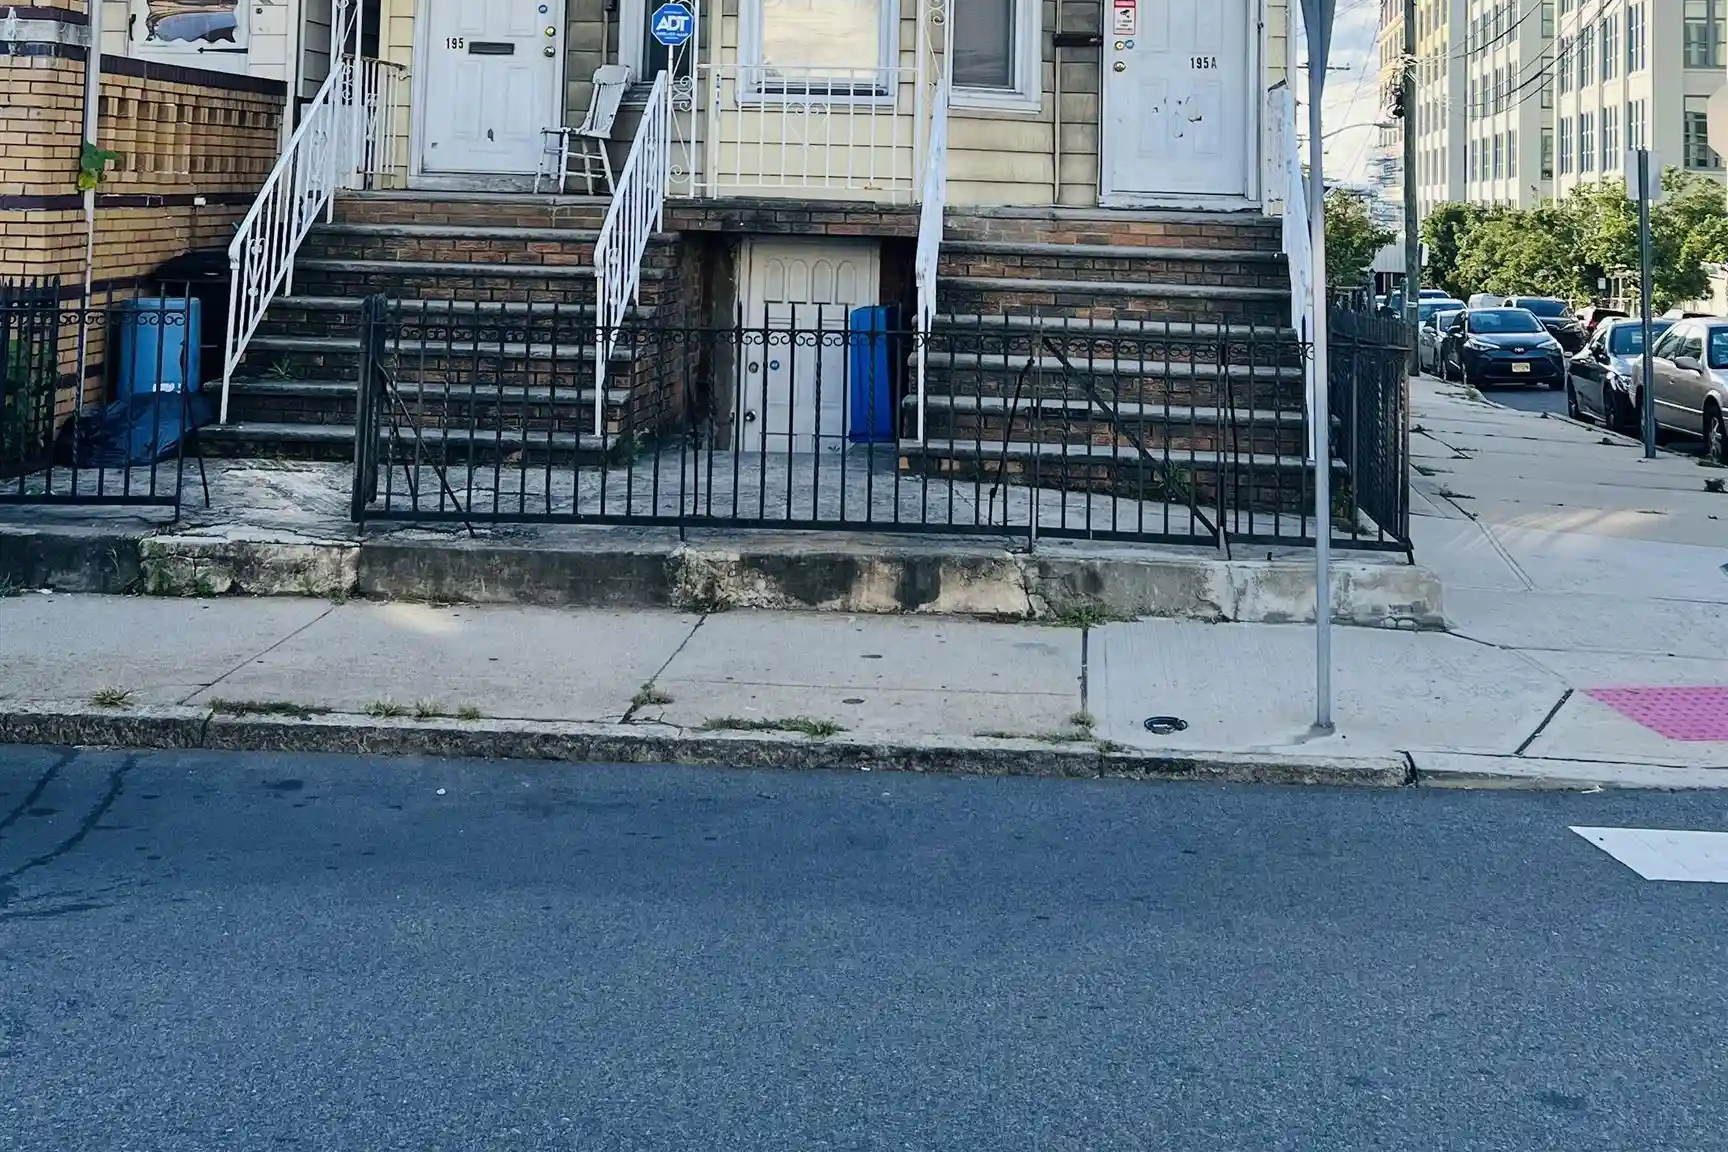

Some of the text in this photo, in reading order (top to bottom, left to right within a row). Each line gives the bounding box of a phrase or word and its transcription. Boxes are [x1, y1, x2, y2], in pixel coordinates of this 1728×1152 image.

[655, 15, 690, 32] ADT
[446, 37, 464, 49] 195
[1190, 56, 1217, 69] 195A
